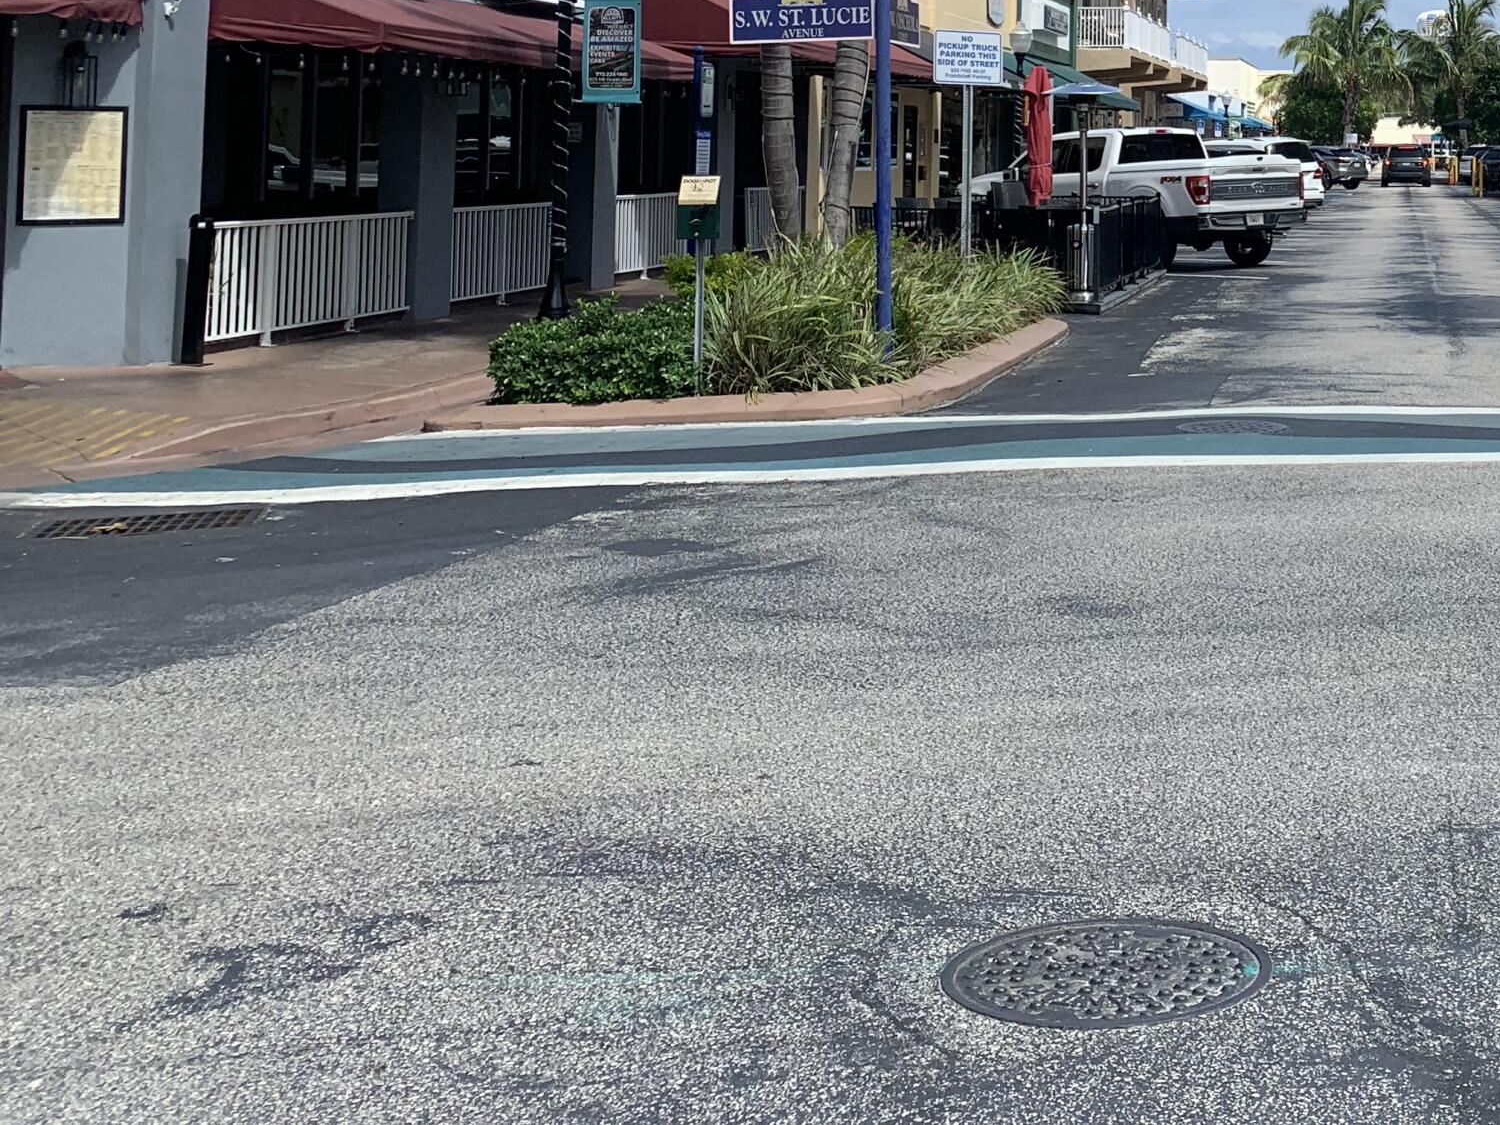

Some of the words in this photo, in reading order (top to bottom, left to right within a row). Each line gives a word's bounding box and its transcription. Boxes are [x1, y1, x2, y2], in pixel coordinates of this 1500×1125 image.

[734, 9, 773, 28] S.W.
[778, 8, 805, 26] ST.
[811, 6, 871, 25] LUCIE
[781, 28, 825, 39] AVENUE
[938, 42, 969, 50] PICKUP
[971, 44, 998, 52] TRUCK
[939, 51, 976, 59] PARKING
[978, 52, 997, 60] THIS
